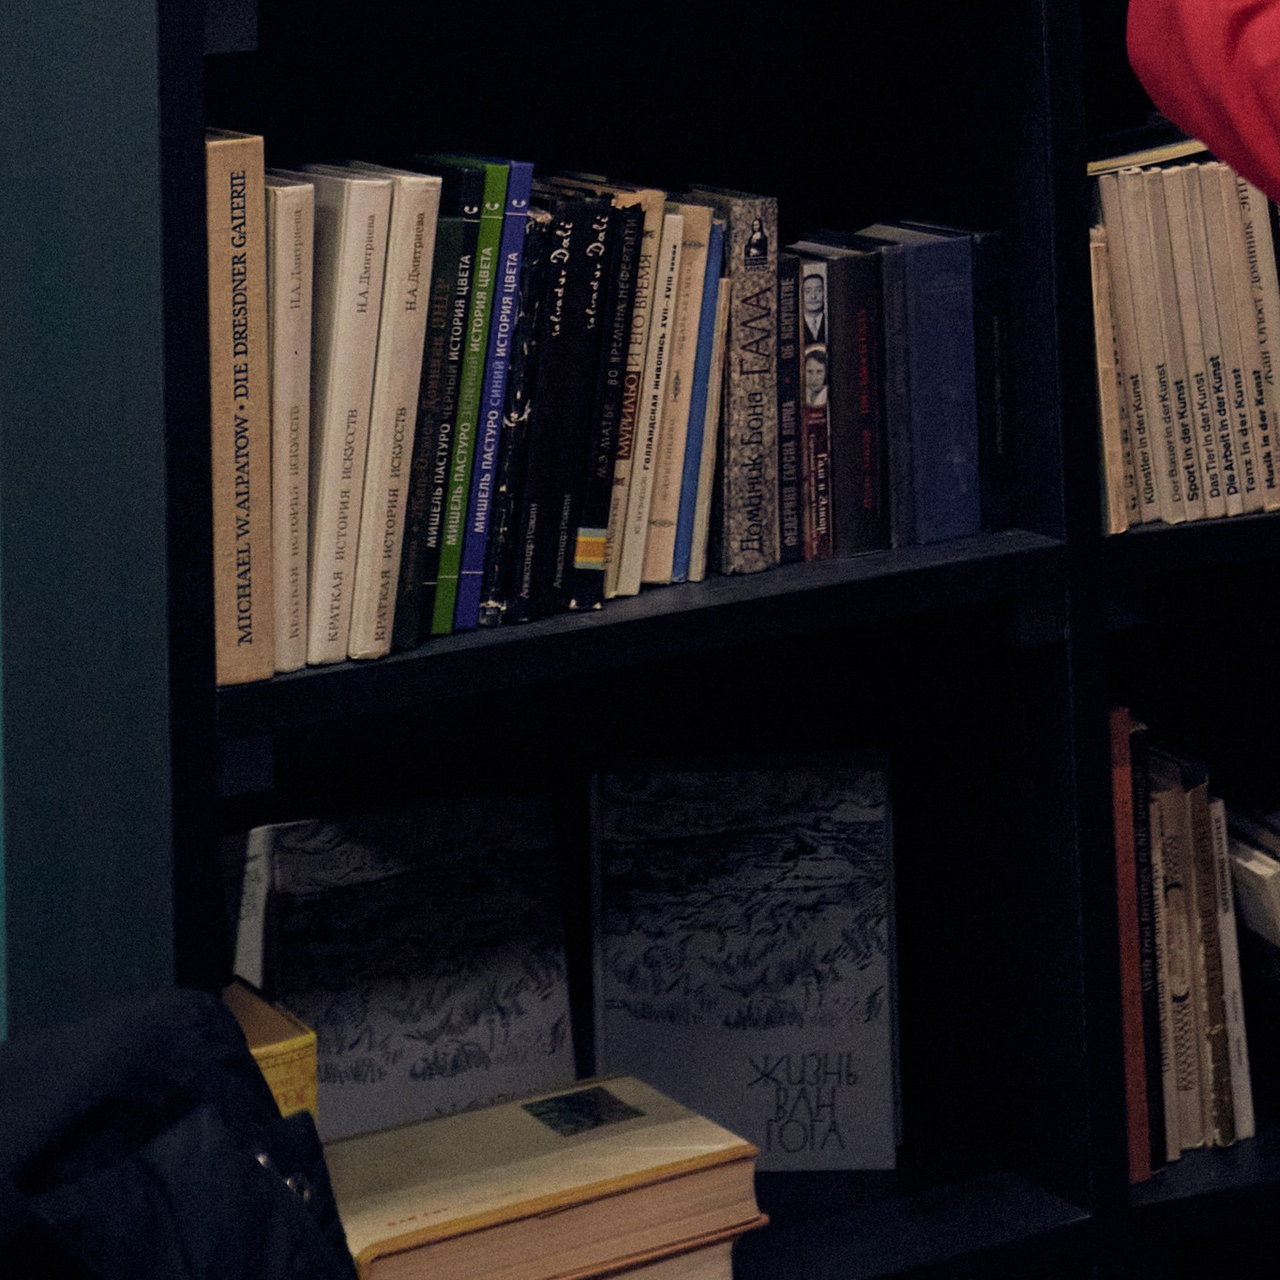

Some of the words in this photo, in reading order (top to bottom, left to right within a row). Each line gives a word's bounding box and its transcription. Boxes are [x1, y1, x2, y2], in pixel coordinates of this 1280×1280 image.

[229, 171, 246, 248] GALERIE
[455, 255, 472, 295] ЦВЕТА
[477, 247, 493, 287] ЦВЕТА
[502, 252, 519, 293] ЦВЕТА
[1244, 221, 1263, 291] Доминик
[231, 253, 248, 358] DRESDNER
[447, 300, 466, 360] ИСТОРИЯ
[469, 291, 487, 352] ИСТОРИЯ
[494, 295, 512, 357] ИСТОРИЯ
[740, 287, 771, 376] ГАЛА
[232, 362, 249, 399] DIE
[487, 360, 505, 406] СИНИЙ
[619, 374, 639, 457] МУРИЛЬО
[636, 253, 651, 309] ВРЕМЯ
[1155, 363, 1167, 401] Kunst
[1209, 355, 1221, 394] Kunst
[1261, 351, 1275, 386] Жан
[1130, 373, 1143, 411] Kunst
[1174, 379, 1186, 419] Kunst
[1194, 372, 1206, 410] Kunst
[1231, 368, 1244, 409] Kunst
[1252, 369, 1264, 406] Kunst
[340, 408, 358, 480] ИСКУССТВ
[389, 407, 407, 479] ИСКУССТВ
[481, 410, 499, 469] ПАСТУРО
[743, 392, 762, 445] Бона
[433, 423, 451, 483] ПАСТУРО
[454, 422, 471, 482] ПАСТУРО
[1220, 433, 1234, 471] Arbeit
[1262, 451, 1276, 489] Musik
[473, 472, 490, 533] МИШЕЛЬ
[741, 454, 763, 552] Доминик
[1184, 464, 1199, 501] Sport
[333, 489, 350, 560] ИСТОРИЯ
[381, 488, 399, 559] ИСТОРИЯ
[425, 487, 442, 547] МИШЕЛЬ
[445, 486, 463, 545] МИШЕЛЬ
[235, 538, 252, 646] MICHAEL
[326, 571, 344, 642] КРАТКАЯ
[374, 570, 392, 641] КРАТКАЯ
[748, 1052, 859, 1089] ЖИЗНЬ
[774, 1086, 836, 1121] ВАН
[766, 1118, 847, 1153] ГОГА
